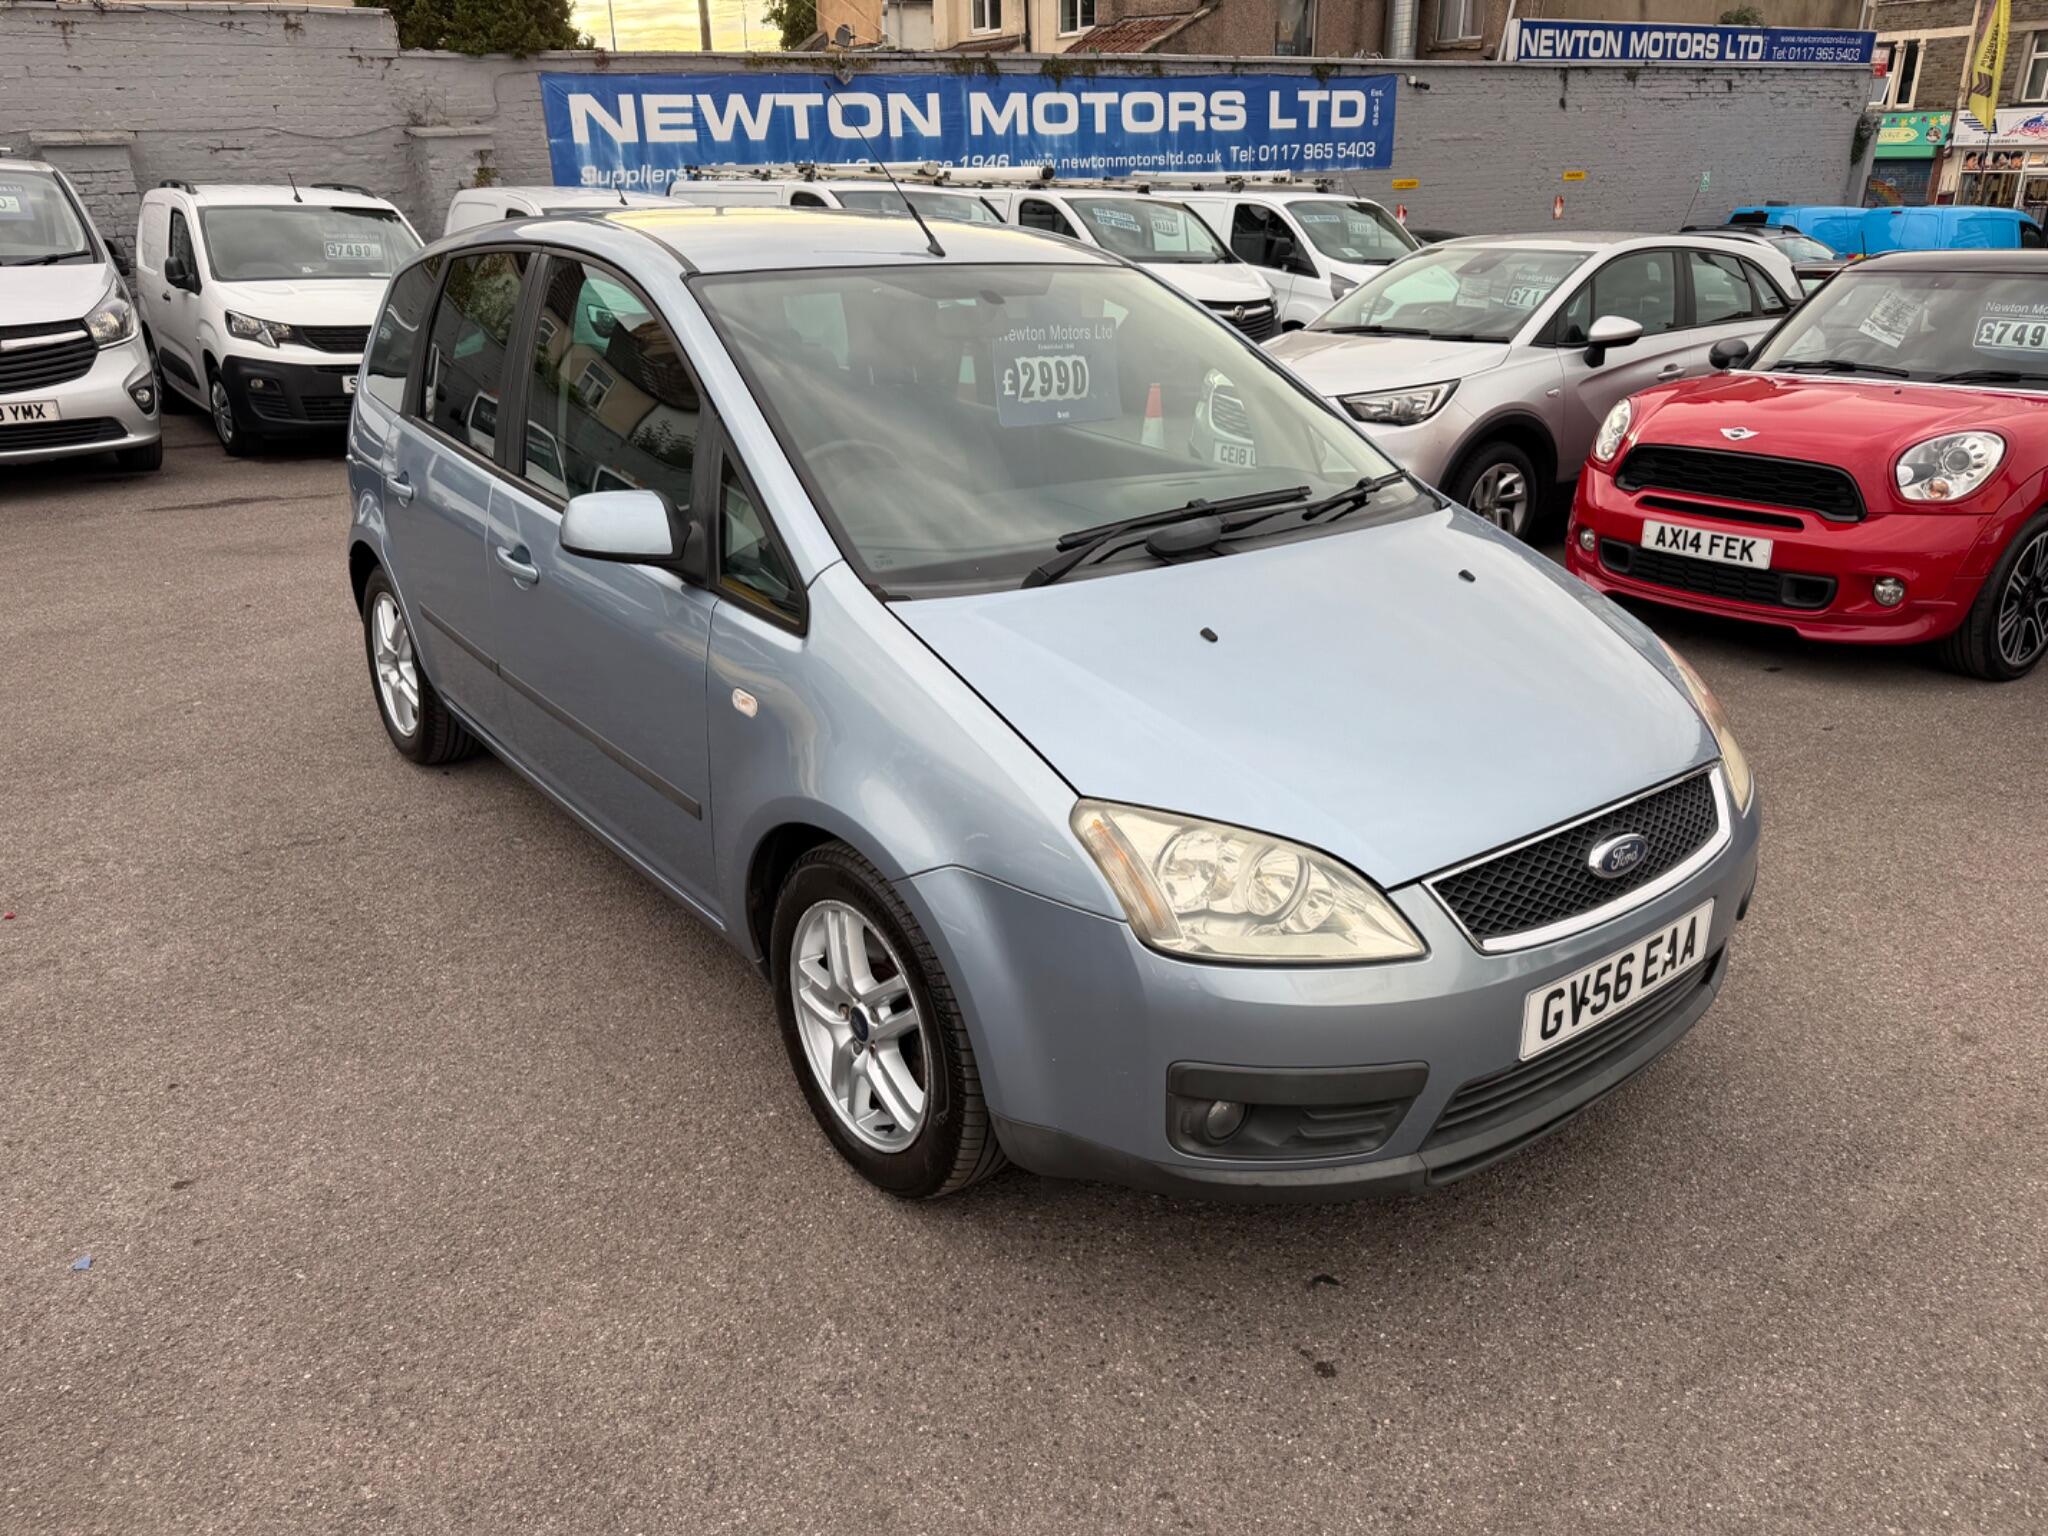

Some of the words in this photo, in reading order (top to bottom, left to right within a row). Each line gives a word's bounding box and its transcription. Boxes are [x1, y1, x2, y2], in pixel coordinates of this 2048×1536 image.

[1520, 28, 1622, 58] NEWTON
[1629, 31, 1720, 60] MOTORS
[1725, 34, 1763, 60] LTD
[1788, 46, 1815, 60] 0117
[1815, 47, 1834, 60] 965
[1835, 48, 1860, 60] 5403
[567, 92, 941, 144] NEWTON
[969, 90, 1247, 136] MOTORS
[1269, 89, 1366, 129] LTD
[960, 154, 1009, 168] 1946
[1020, 149, 1221, 169] www.newtonmotorsltd.co.uk
[1230, 145, 1255, 162] Tel:
[1258, 144, 1300, 161] 0117
[1303, 142, 1334, 160] 965
[1337, 141, 1376, 158] 5403
[580, 164, 688, 188] Suppliers
[326, 242, 371, 257] £7490
[1985, 301, 2029, 313] Newton
[999, 325, 1046, 341] ewton
[1050, 323, 1091, 340] Motors
[1095, 323, 1113, 340] Ltd
[1002, 359, 1087, 399] £2990
[9, 403, 47, 421] YMX
[1220, 445, 1247, 465] CE18
[1655, 525, 1702, 553] AX14
[1708, 534, 1757, 562] FEK
[1611, 843, 1640, 871] Ford
[1540, 952, 1635, 1040] GV56
[1641, 916, 1697, 989] EAA
